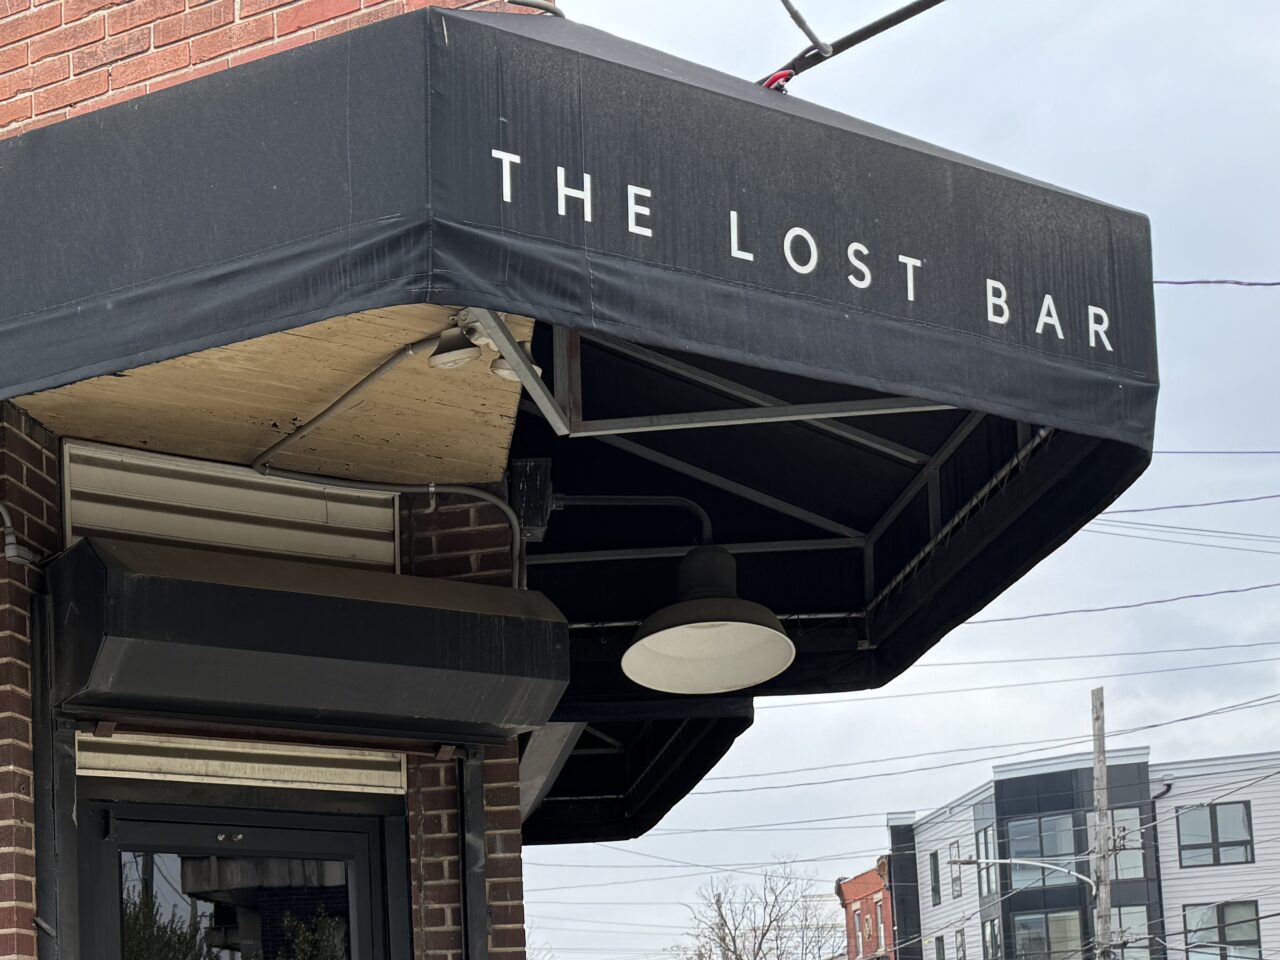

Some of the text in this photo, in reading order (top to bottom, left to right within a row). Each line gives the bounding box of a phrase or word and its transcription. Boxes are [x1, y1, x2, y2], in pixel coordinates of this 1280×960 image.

[491, 149, 1114, 352] THE LOST BAR
